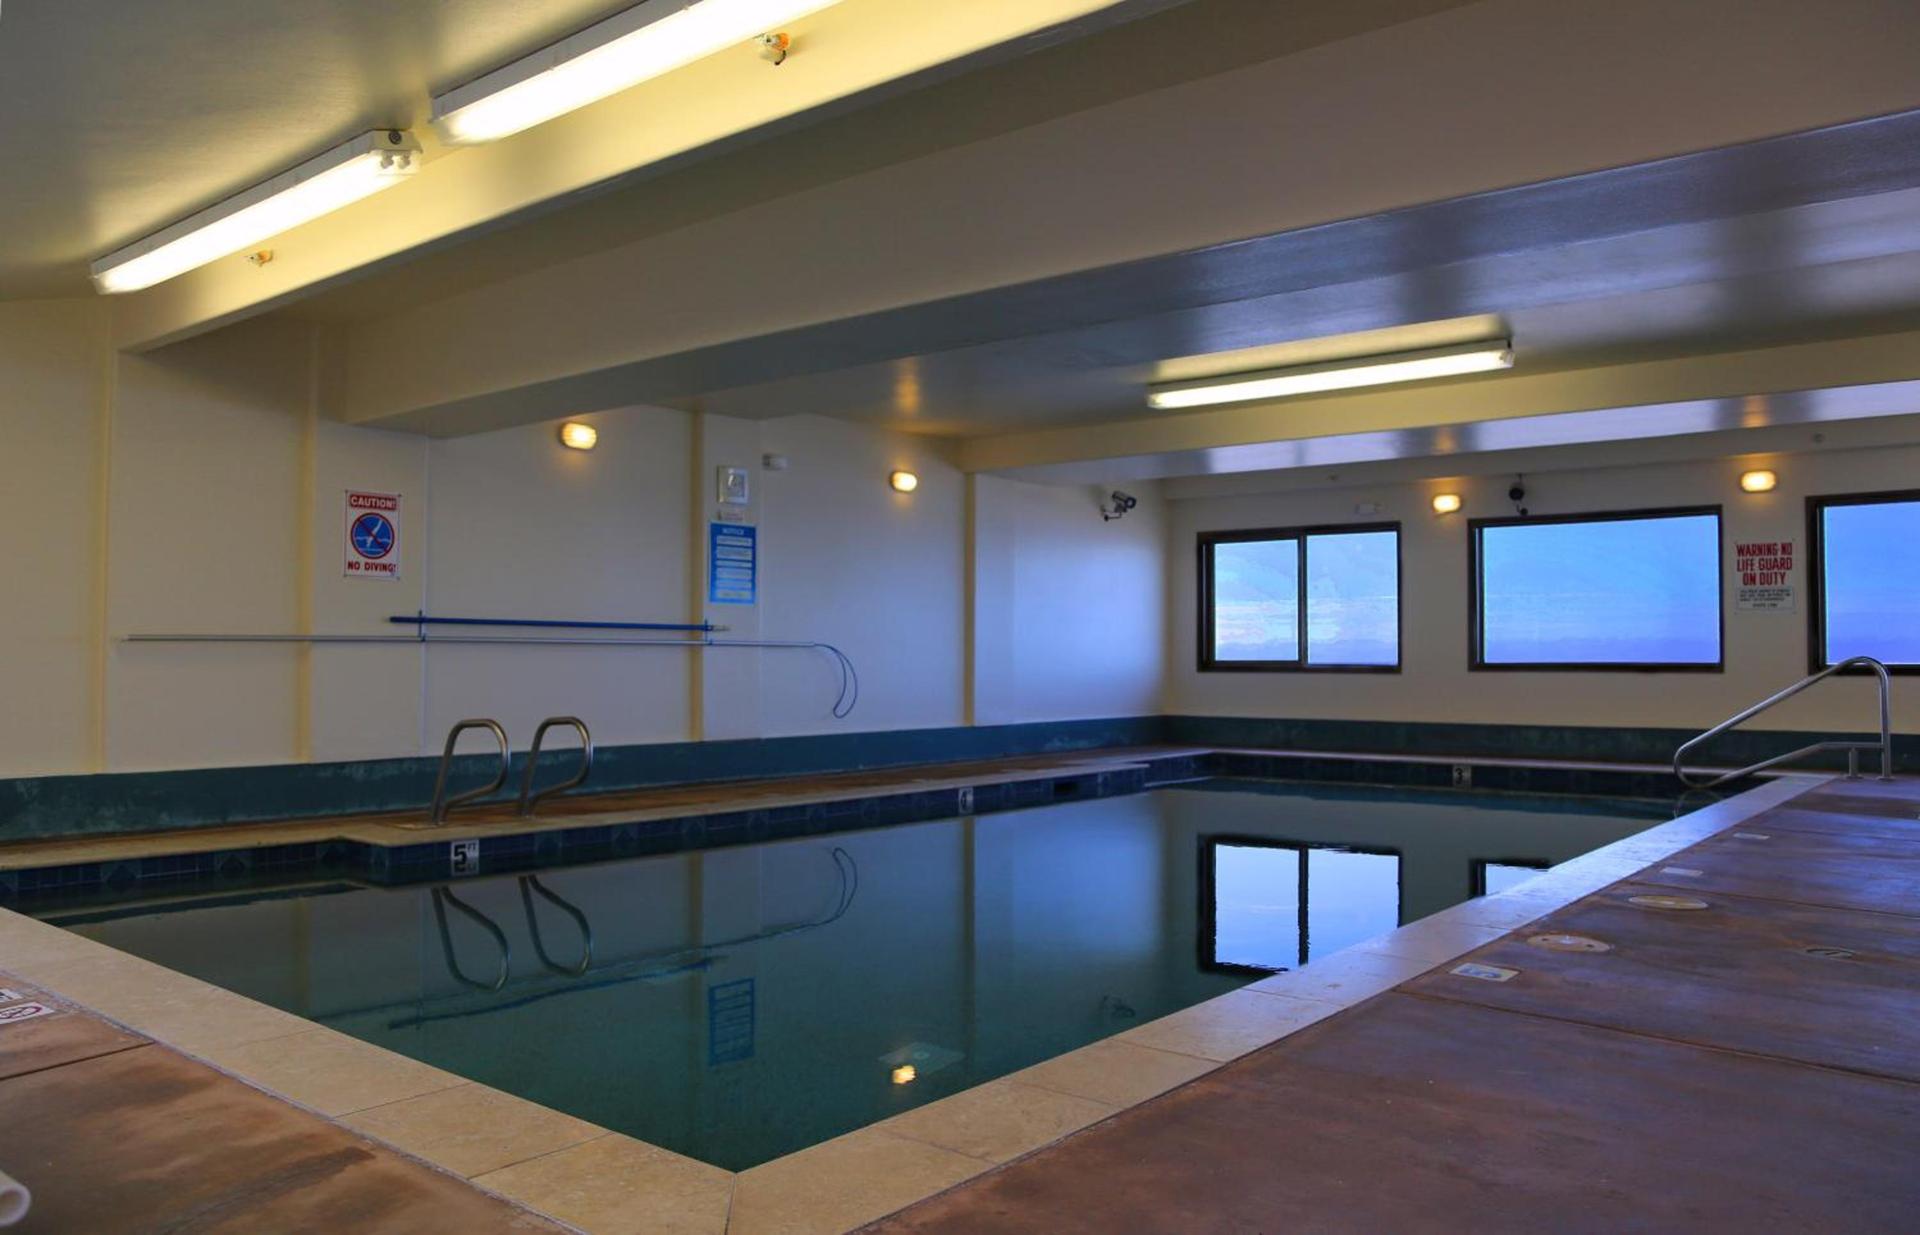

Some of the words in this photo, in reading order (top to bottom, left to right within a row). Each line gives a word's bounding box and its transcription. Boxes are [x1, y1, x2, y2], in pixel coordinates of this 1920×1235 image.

[1736, 543, 1777, 557] WARNING
[1781, 543, 1792, 556] NO
[348, 561, 360, 570] NO
[1737, 558, 1754, 572] LIFE
[1759, 557, 1792, 571] GUARD
[1743, 572, 1756, 586] ON
[1759, 571, 1786, 586] DUTY
[454, 844, 467, 864] 5
